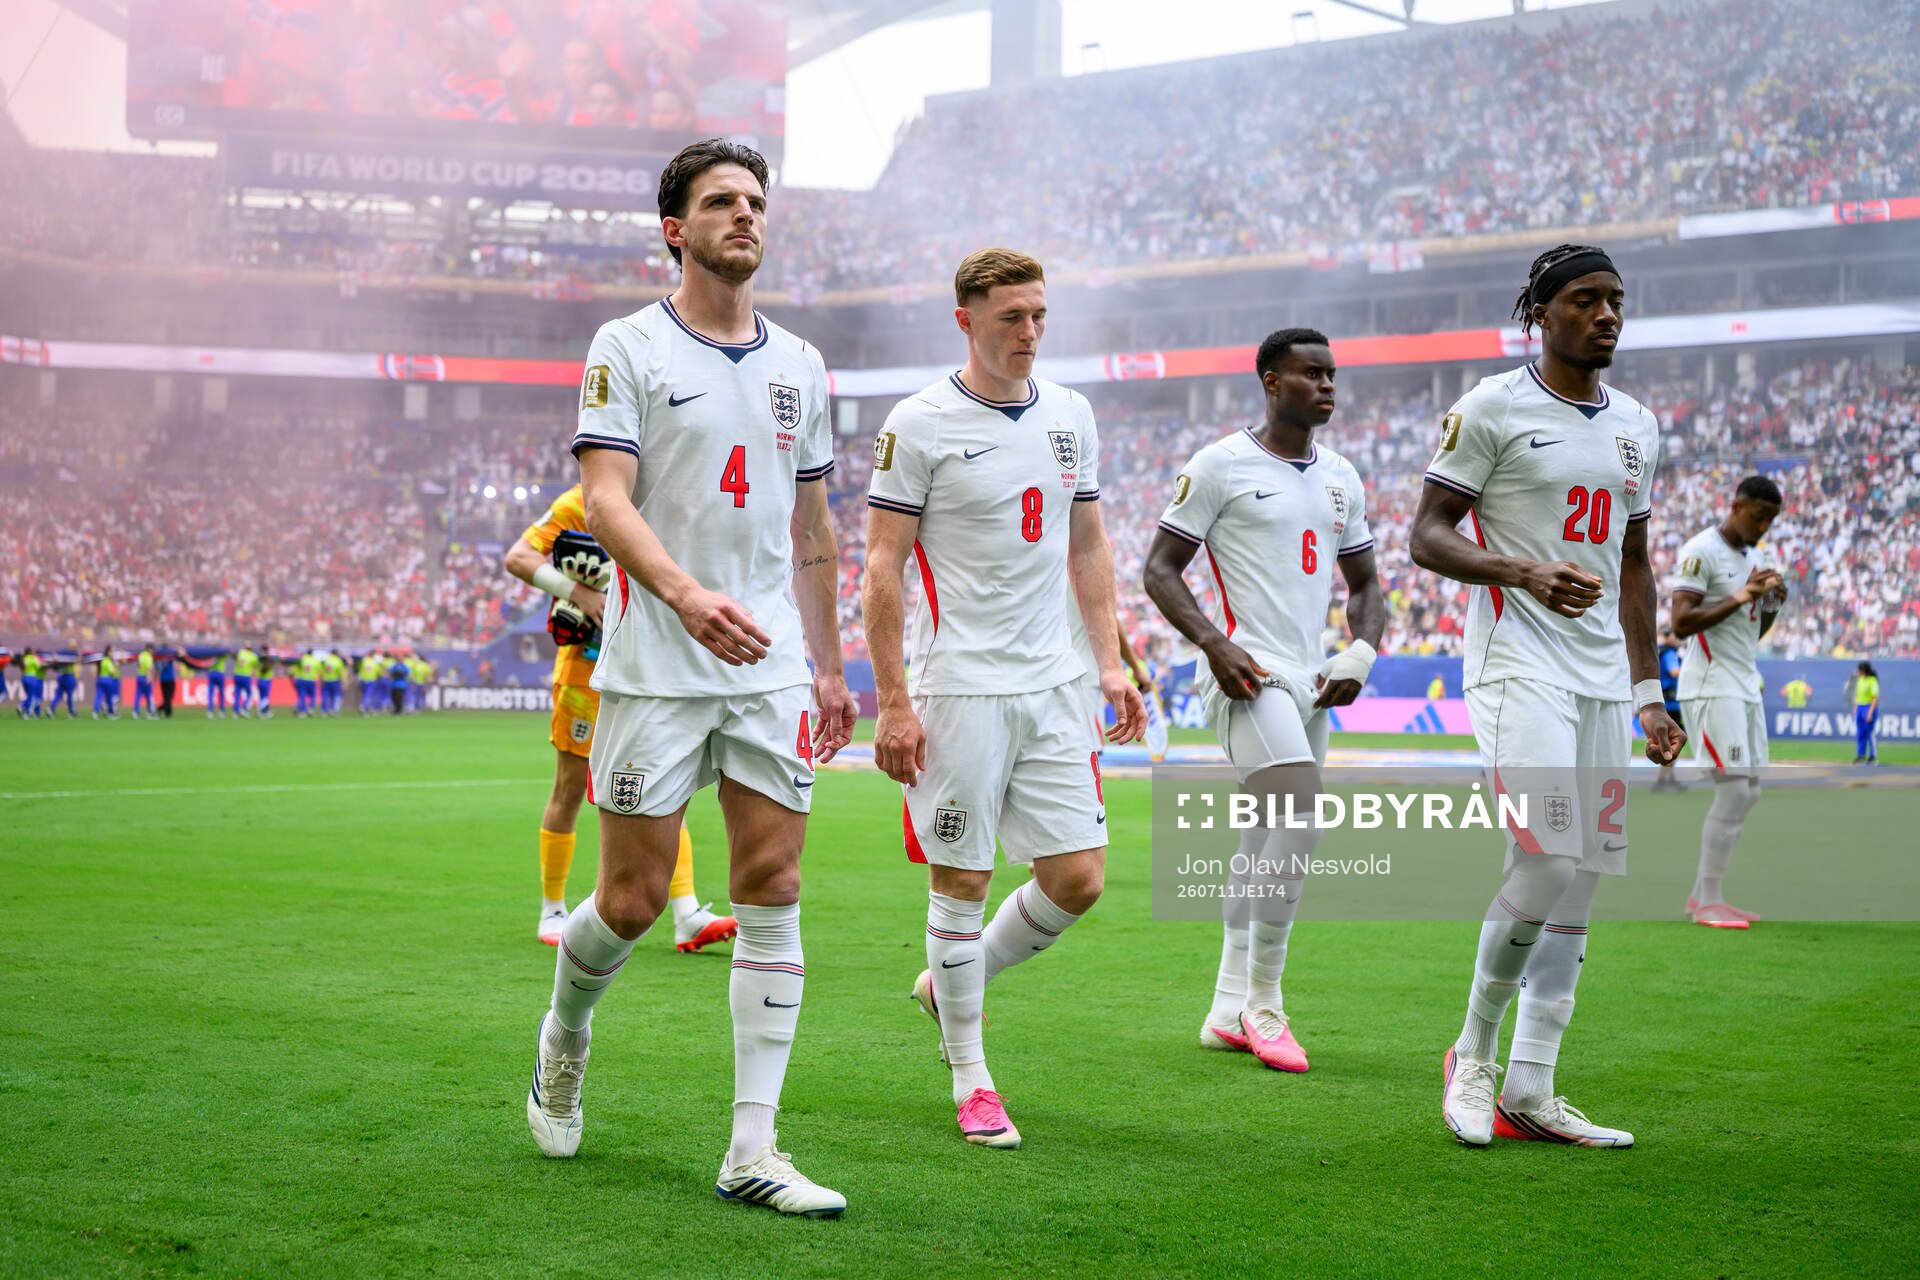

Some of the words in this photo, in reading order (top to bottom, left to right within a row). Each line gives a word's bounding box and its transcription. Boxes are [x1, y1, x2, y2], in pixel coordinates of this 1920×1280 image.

[272, 150, 342, 178] FIFA
[346, 154, 465, 185] WORLD
[471, 161, 534, 188] CUP
[540, 165, 652, 194] 2026
[720, 445, 749, 508] 4
[1021, 487, 1043, 542] 8
[1562, 485, 1611, 544] 20
[1302, 529, 1317, 575] 6
[796, 710, 814, 771] 4
[1777, 712, 1832, 735] FIFA
[1597, 778, 1626, 835] 2
